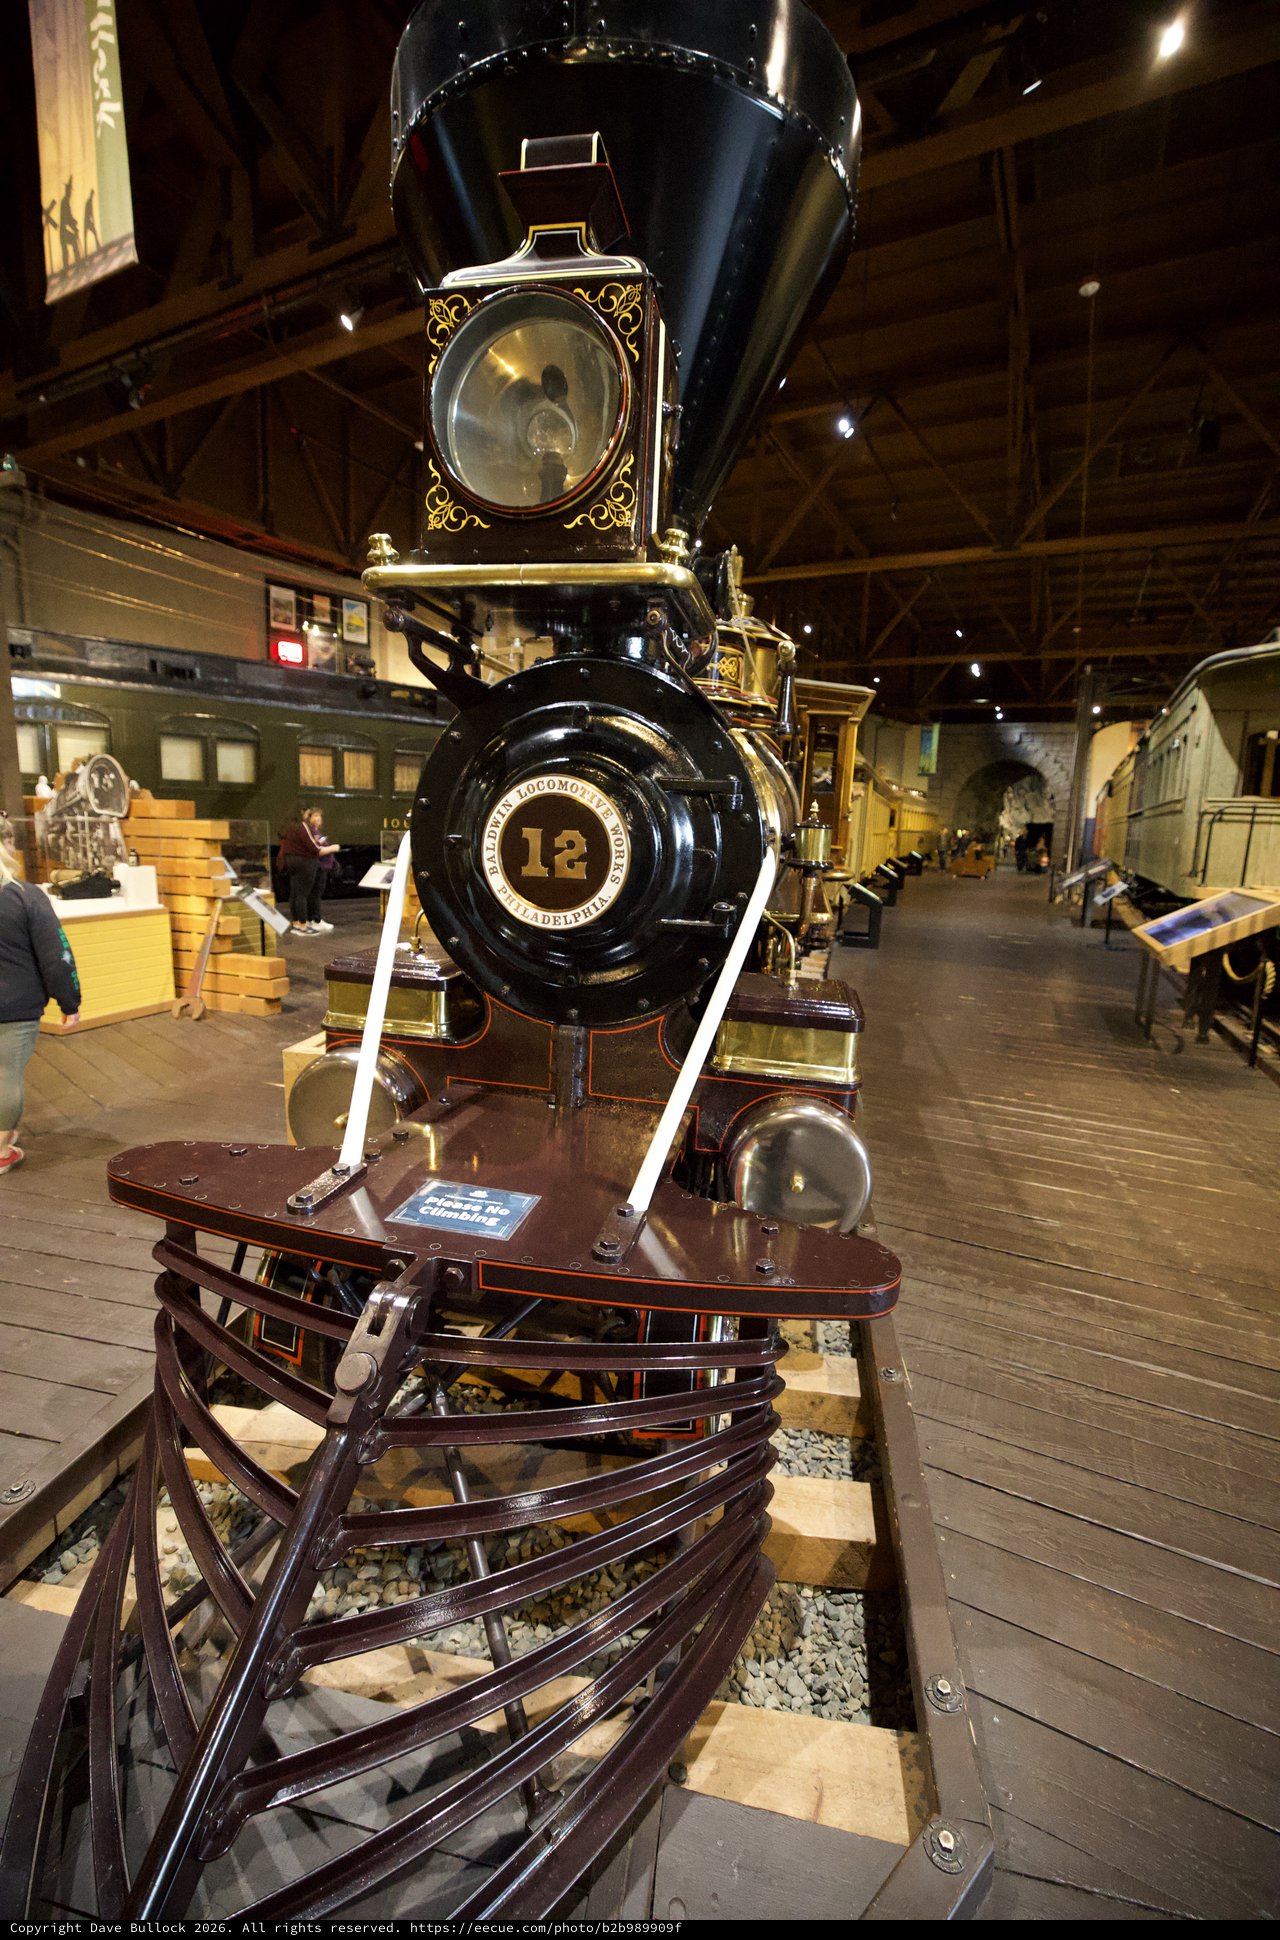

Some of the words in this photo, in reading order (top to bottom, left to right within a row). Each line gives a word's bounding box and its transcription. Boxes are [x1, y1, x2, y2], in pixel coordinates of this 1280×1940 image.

[485, 799, 513, 876] BALDWIN
[516, 779, 614, 820] LOCOMOTIVE
[610, 823, 625, 885] WORKS
[521, 827, 588, 880] 12
[418, 1206, 501, 1226] Climbing
[424, 1196, 483, 1212] Please
[484, 1205, 511, 1216] No
